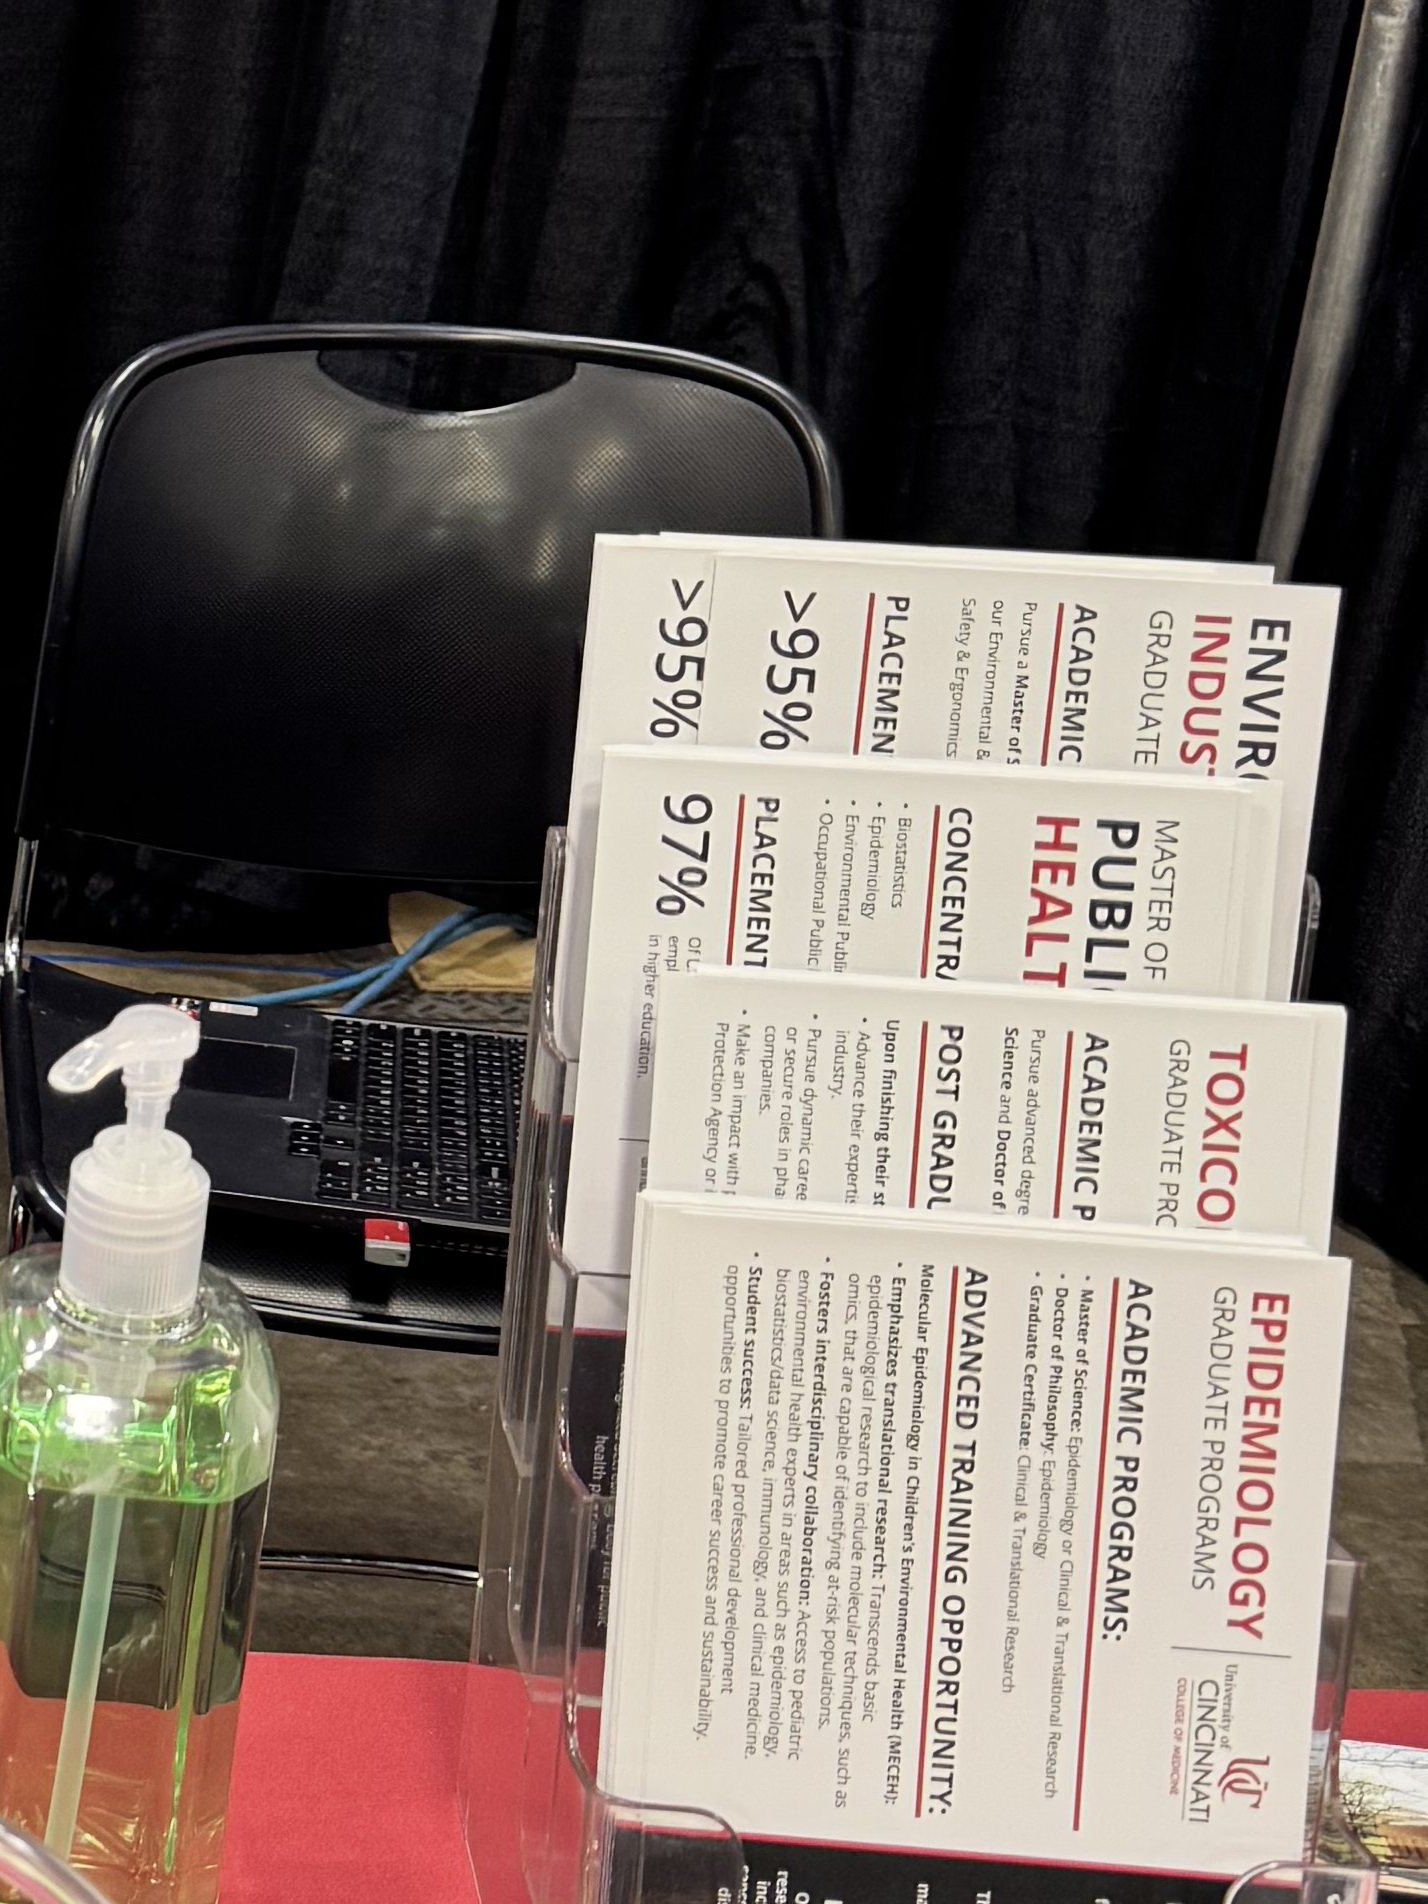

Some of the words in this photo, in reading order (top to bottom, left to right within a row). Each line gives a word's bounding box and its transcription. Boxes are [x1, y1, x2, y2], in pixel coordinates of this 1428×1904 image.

[650, 578, 709, 739] >95%
[760, 590, 820, 750] >95%
[955, 599, 976, 646] Safety
[957, 651, 970, 661] &
[1018, 661, 1027, 669] a
[1019, 603, 1037, 655] Pursue
[871, 595, 910, 755] PLACEMEN
[946, 667, 969, 757] Ergonomics
[1011, 675, 1029, 732] Master
[1059, 604, 1097, 763] ACADEMIC
[1134, 610, 1174, 766] GRADUATE
[1180, 614, 1232, 776] INDUS
[1236, 618, 1291, 780] ENVIR
[1008, 737, 1021, 754] of
[656, 794, 712, 916] 97%
[743, 796, 780, 967] PLACEMENT
[860, 816, 885, 920] Epidemiology
[890, 818, 911, 908] Biostatistics
[1147, 821, 1180, 931] MASTER
[1084, 819, 1139, 991] PUBLI
[1144, 942, 1168, 980] OF
[935, 1025, 964, 1102] POST
[1160, 1039, 1191, 1174] GRADUATE
[1073, 1032, 1109, 1193] ACADEMIC
[1196, 1043, 1248, 1231] TOXICO
[956, 1267, 988, 1429] ADVANCED
[1051, 1345, 1064, 1361] of
[1053, 1288, 1068, 1340] Doctor
[1076, 1349, 1089, 1365] of
[1078, 1290, 1093, 1344] Master
[1117, 1279, 1153, 1445] ACADEMIC
[1204, 1287, 1237, 1430] GRADUATE
[1041, 1366, 1063, 1454] Philosophy:
[1069, 1369, 1088, 1432] Science:
[945, 1440, 976, 1584] TRAINING
[1033, 1461, 1055, 1558] Epidemiology
[1060, 1437, 1082, 1535] Epidemiology
[1227, 1291, 1290, 1640] EPIDEMIOLOGY
[1063, 1540, 1072, 1555] or
[1102, 1456, 1140, 1641] PROGRAMS:
[1192, 1440, 1225, 1590] PROGRAMS
[1057, 1617, 1069, 1626] &
[1058, 1560, 1073, 1610] Clinical
[929, 1595, 965, 1814] OPPORTUNITY:
[1050, 1633, 1068, 1726] Translational
[1174, 1678, 1187, 1724] COLLEGE
[1219, 1664, 1238, 1731] University
[1046, 1732, 1061, 1797] Research
[1170, 1745, 1181, 1795] MEDICINE
[1188, 1679, 1220, 1823] CINCINNATI
[1220, 1736, 1231, 1749] of
